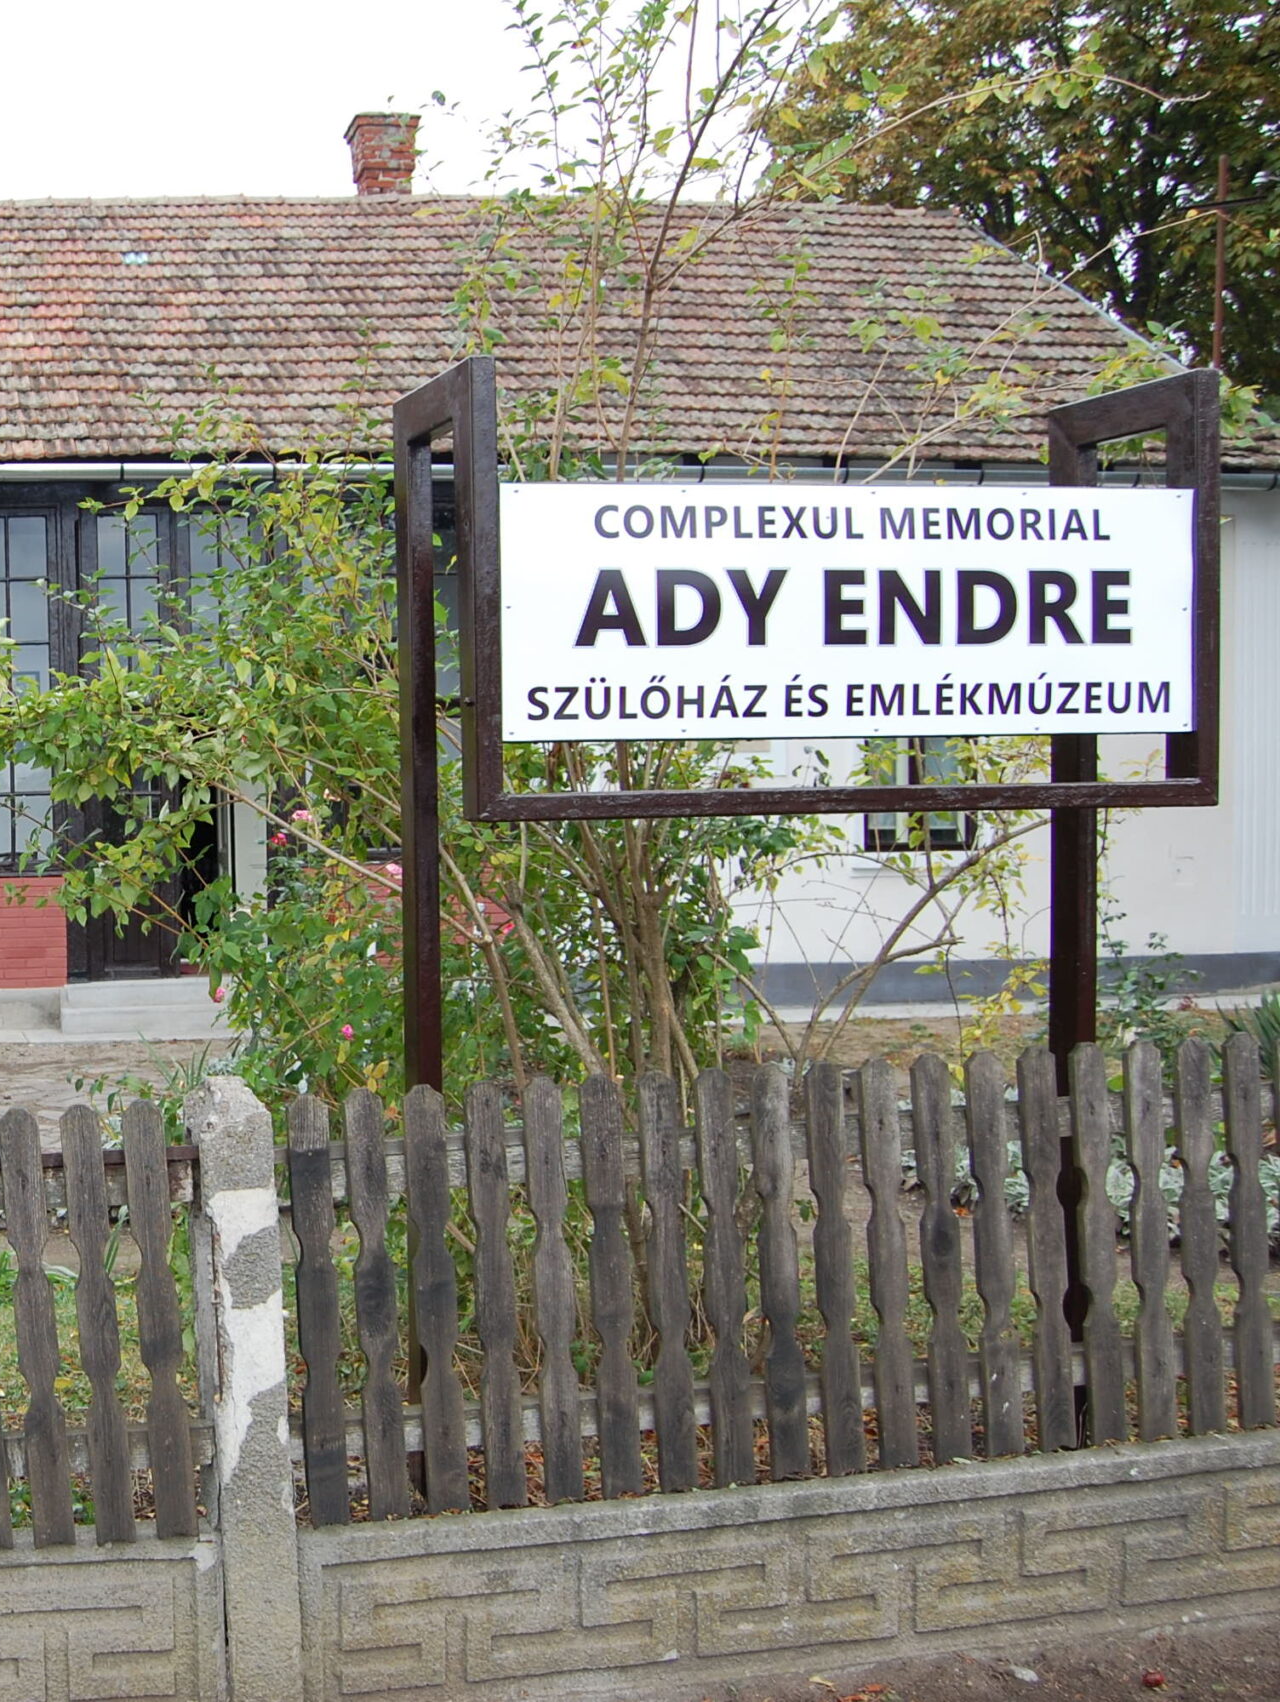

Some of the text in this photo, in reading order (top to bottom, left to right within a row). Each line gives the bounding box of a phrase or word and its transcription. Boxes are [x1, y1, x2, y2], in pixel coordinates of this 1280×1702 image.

[593, 504, 1111, 541] COMPLEXUL MEMORIAL
[574, 569, 1132, 647] ADY ENDRE
[526, 672, 1171, 721] SZÜLŐHÁZ ÉS EMLÉKMÚZEUM
